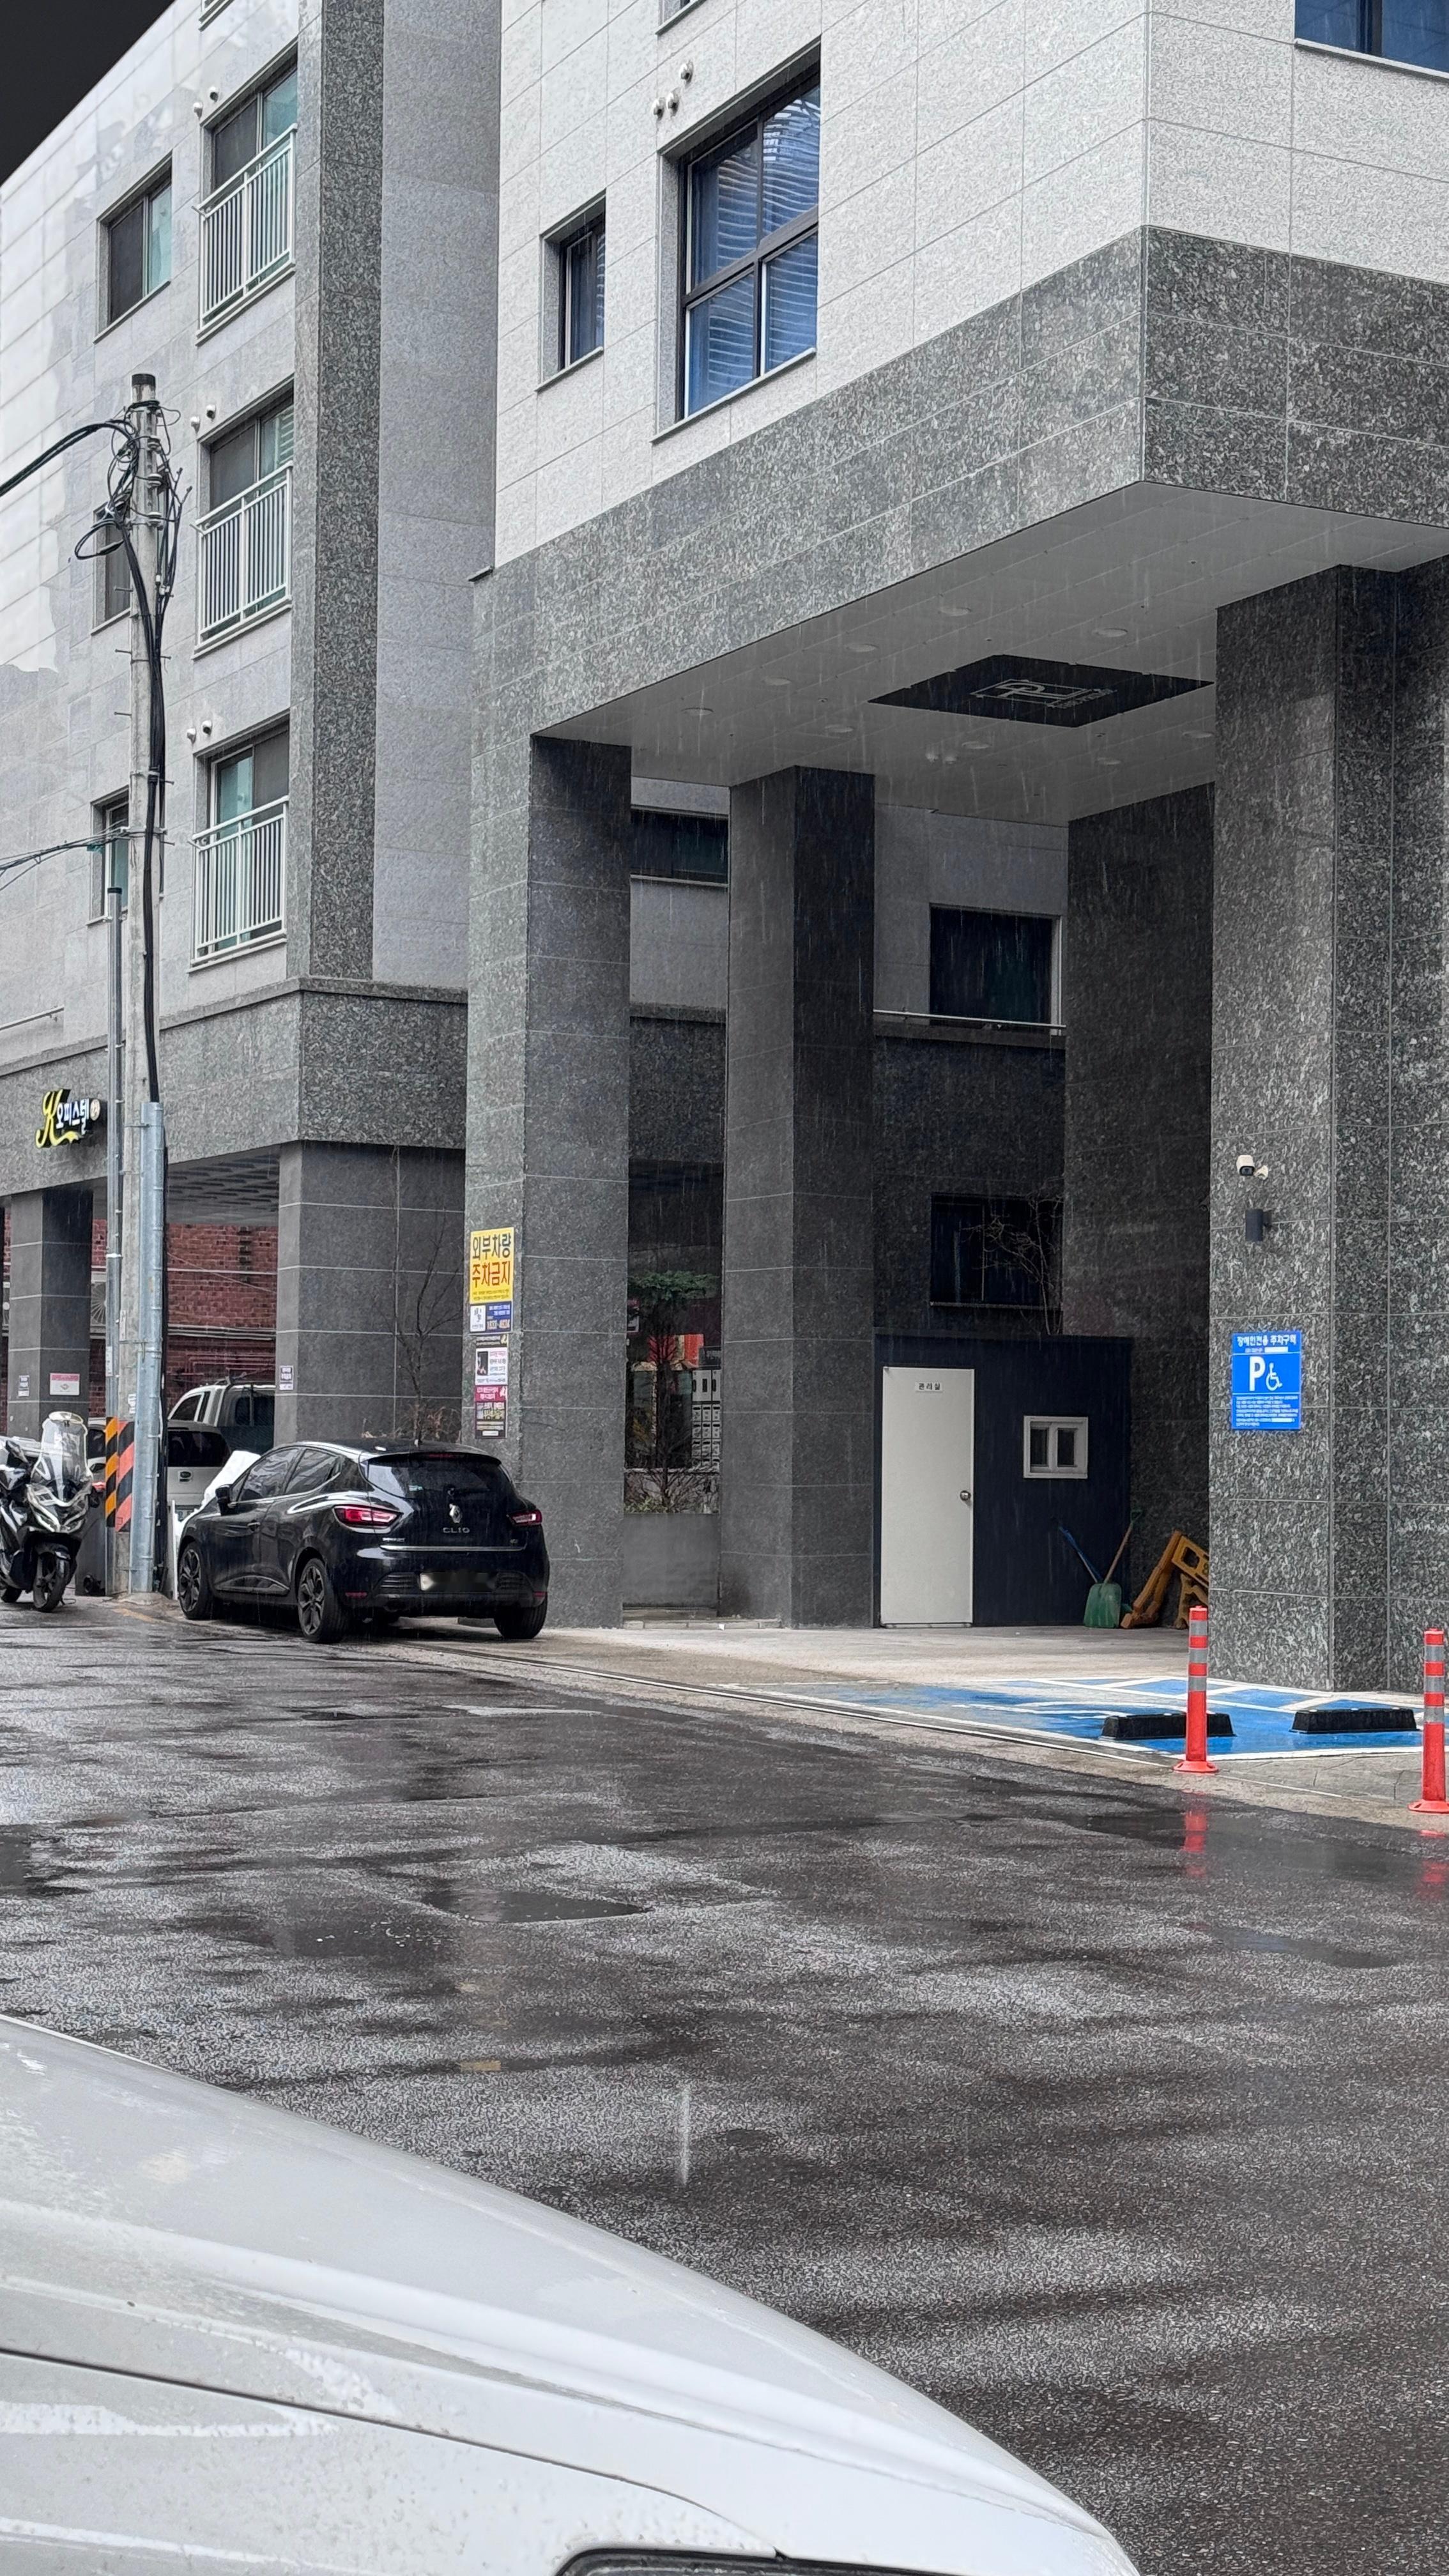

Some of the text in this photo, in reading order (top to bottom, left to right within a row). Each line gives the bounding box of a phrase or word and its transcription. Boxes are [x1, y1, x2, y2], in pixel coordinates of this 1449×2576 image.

[56, 1099, 89, 1135] 오피스텔
[472, 1234, 511, 1261] 외부차량
[472, 1261, 510, 1289] 주차금지
[1270, 1334, 1297, 1346] 주차구역
[918, 1383, 940, 1391] 관리실
[1249, 1356, 1266, 1392] P
